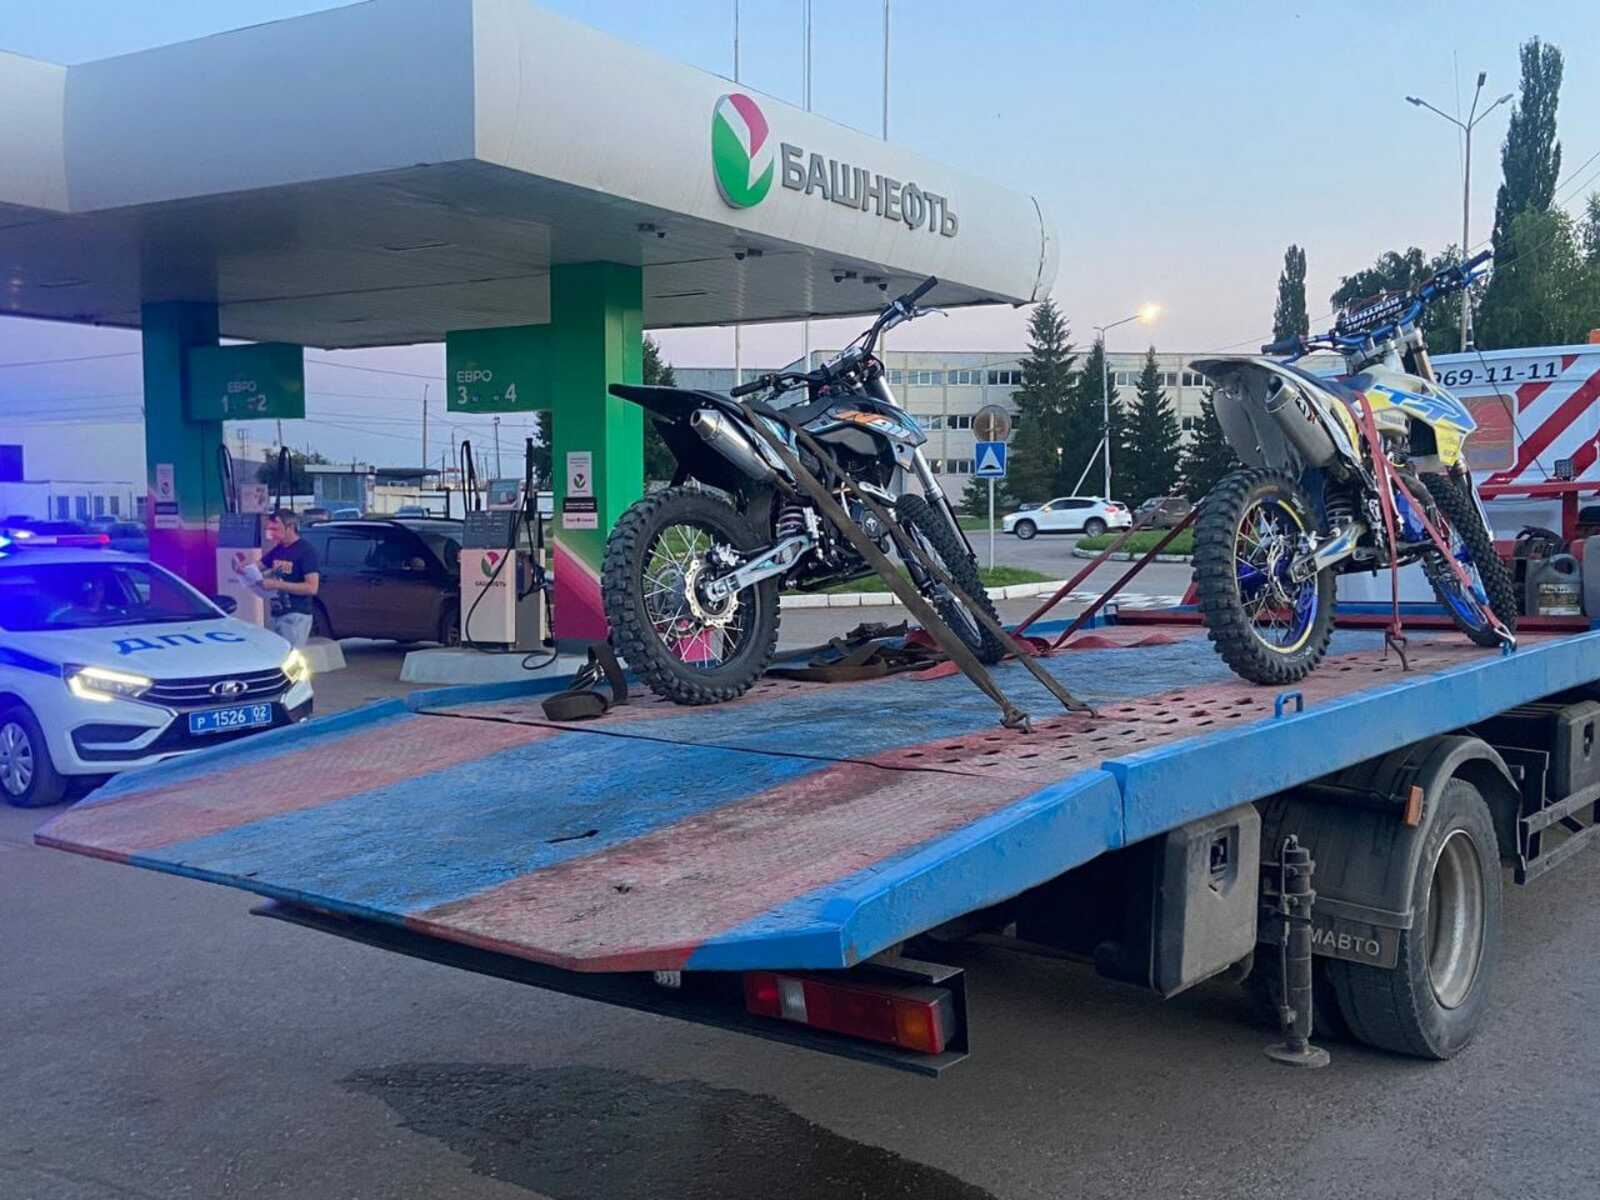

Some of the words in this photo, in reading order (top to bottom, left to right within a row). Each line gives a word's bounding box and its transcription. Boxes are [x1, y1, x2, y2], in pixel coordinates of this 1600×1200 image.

[780, 142, 959, 237] БАШНЕФТЬ
[457, 370, 493, 383] ЕВРО
[257, 394, 267, 412] 2
[457, 386, 468, 404] 3
[504, 383, 517, 403] 4
[112, 631, 246, 655] ДПС
[212, 709, 246, 726] 1526
[253, 706, 267, 718] 02
